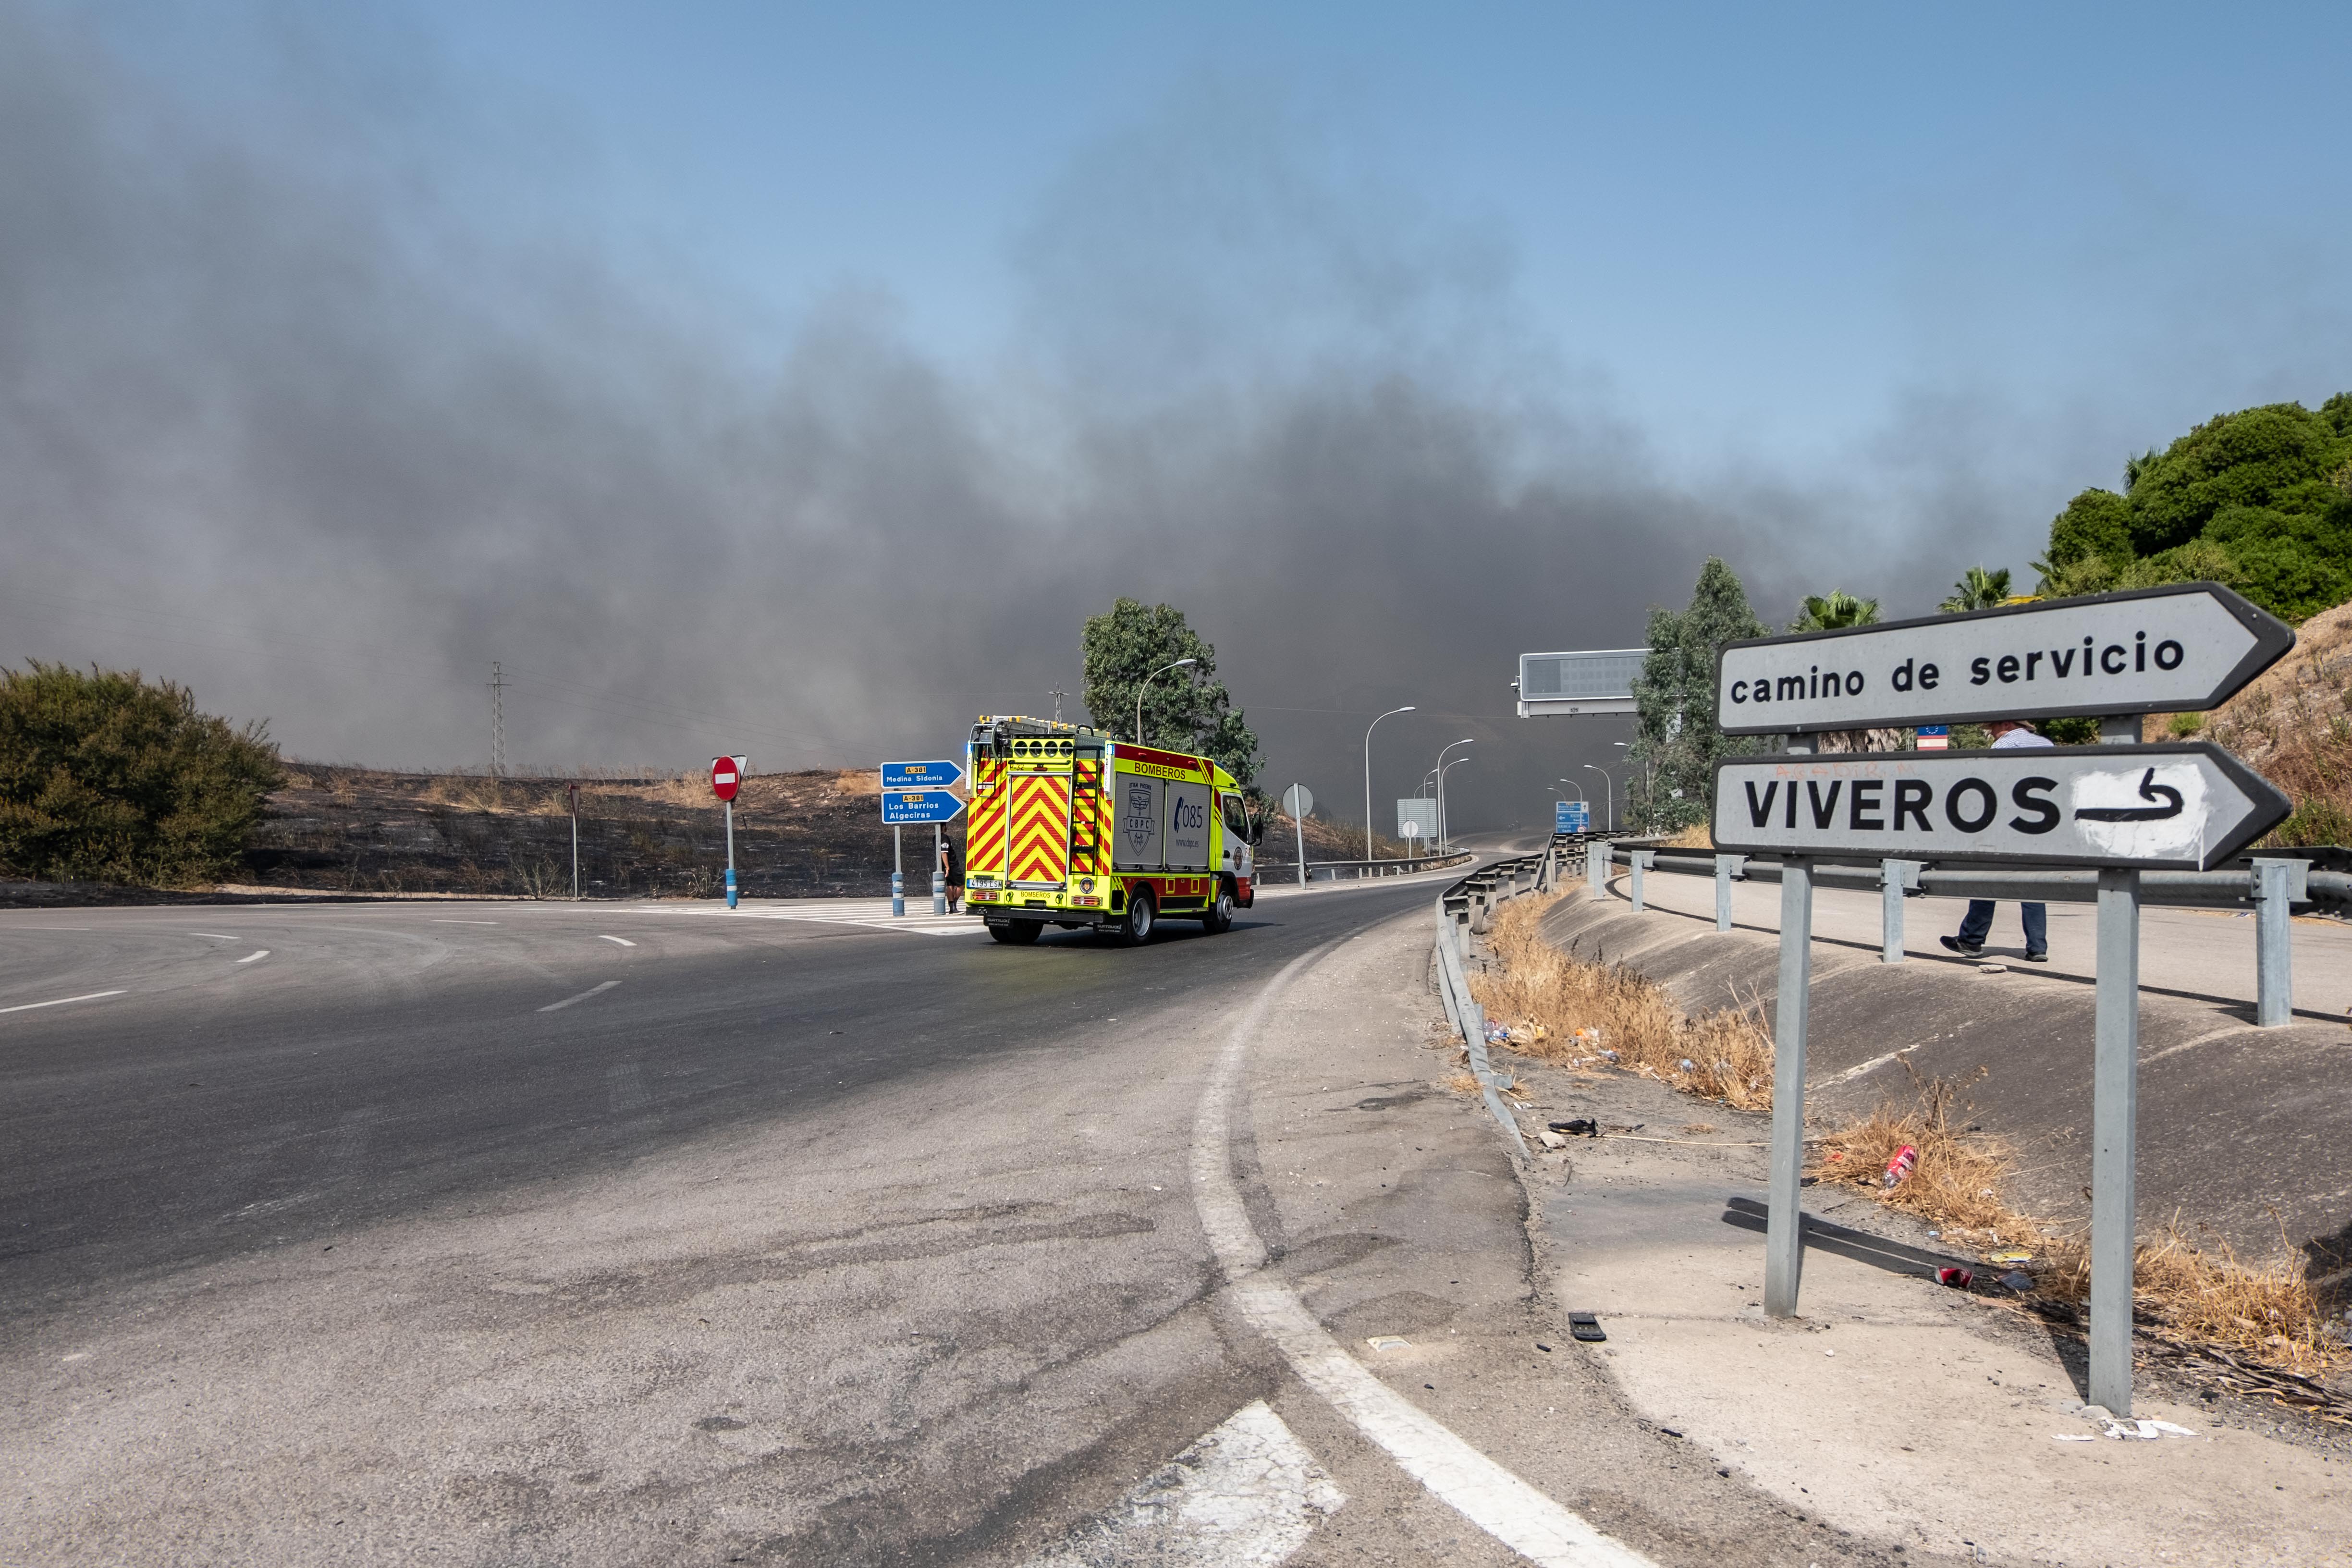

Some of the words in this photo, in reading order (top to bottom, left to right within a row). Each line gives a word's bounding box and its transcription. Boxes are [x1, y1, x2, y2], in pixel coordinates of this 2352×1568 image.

[1731, 665, 1864, 704] camino
[1891, 658, 1939, 692] de
[1970, 631, 2184, 686] servicio
[1134, 762, 1186, 780] BOMBEROS
[1745, 777, 2060, 835] VIVEROS
[889, 811, 931, 820] Algeciras
[1129, 819, 1149, 829] CBPC
[1182, 805, 1203, 828] 085
[1176, 837, 1199, 849] www.cbpc.es
